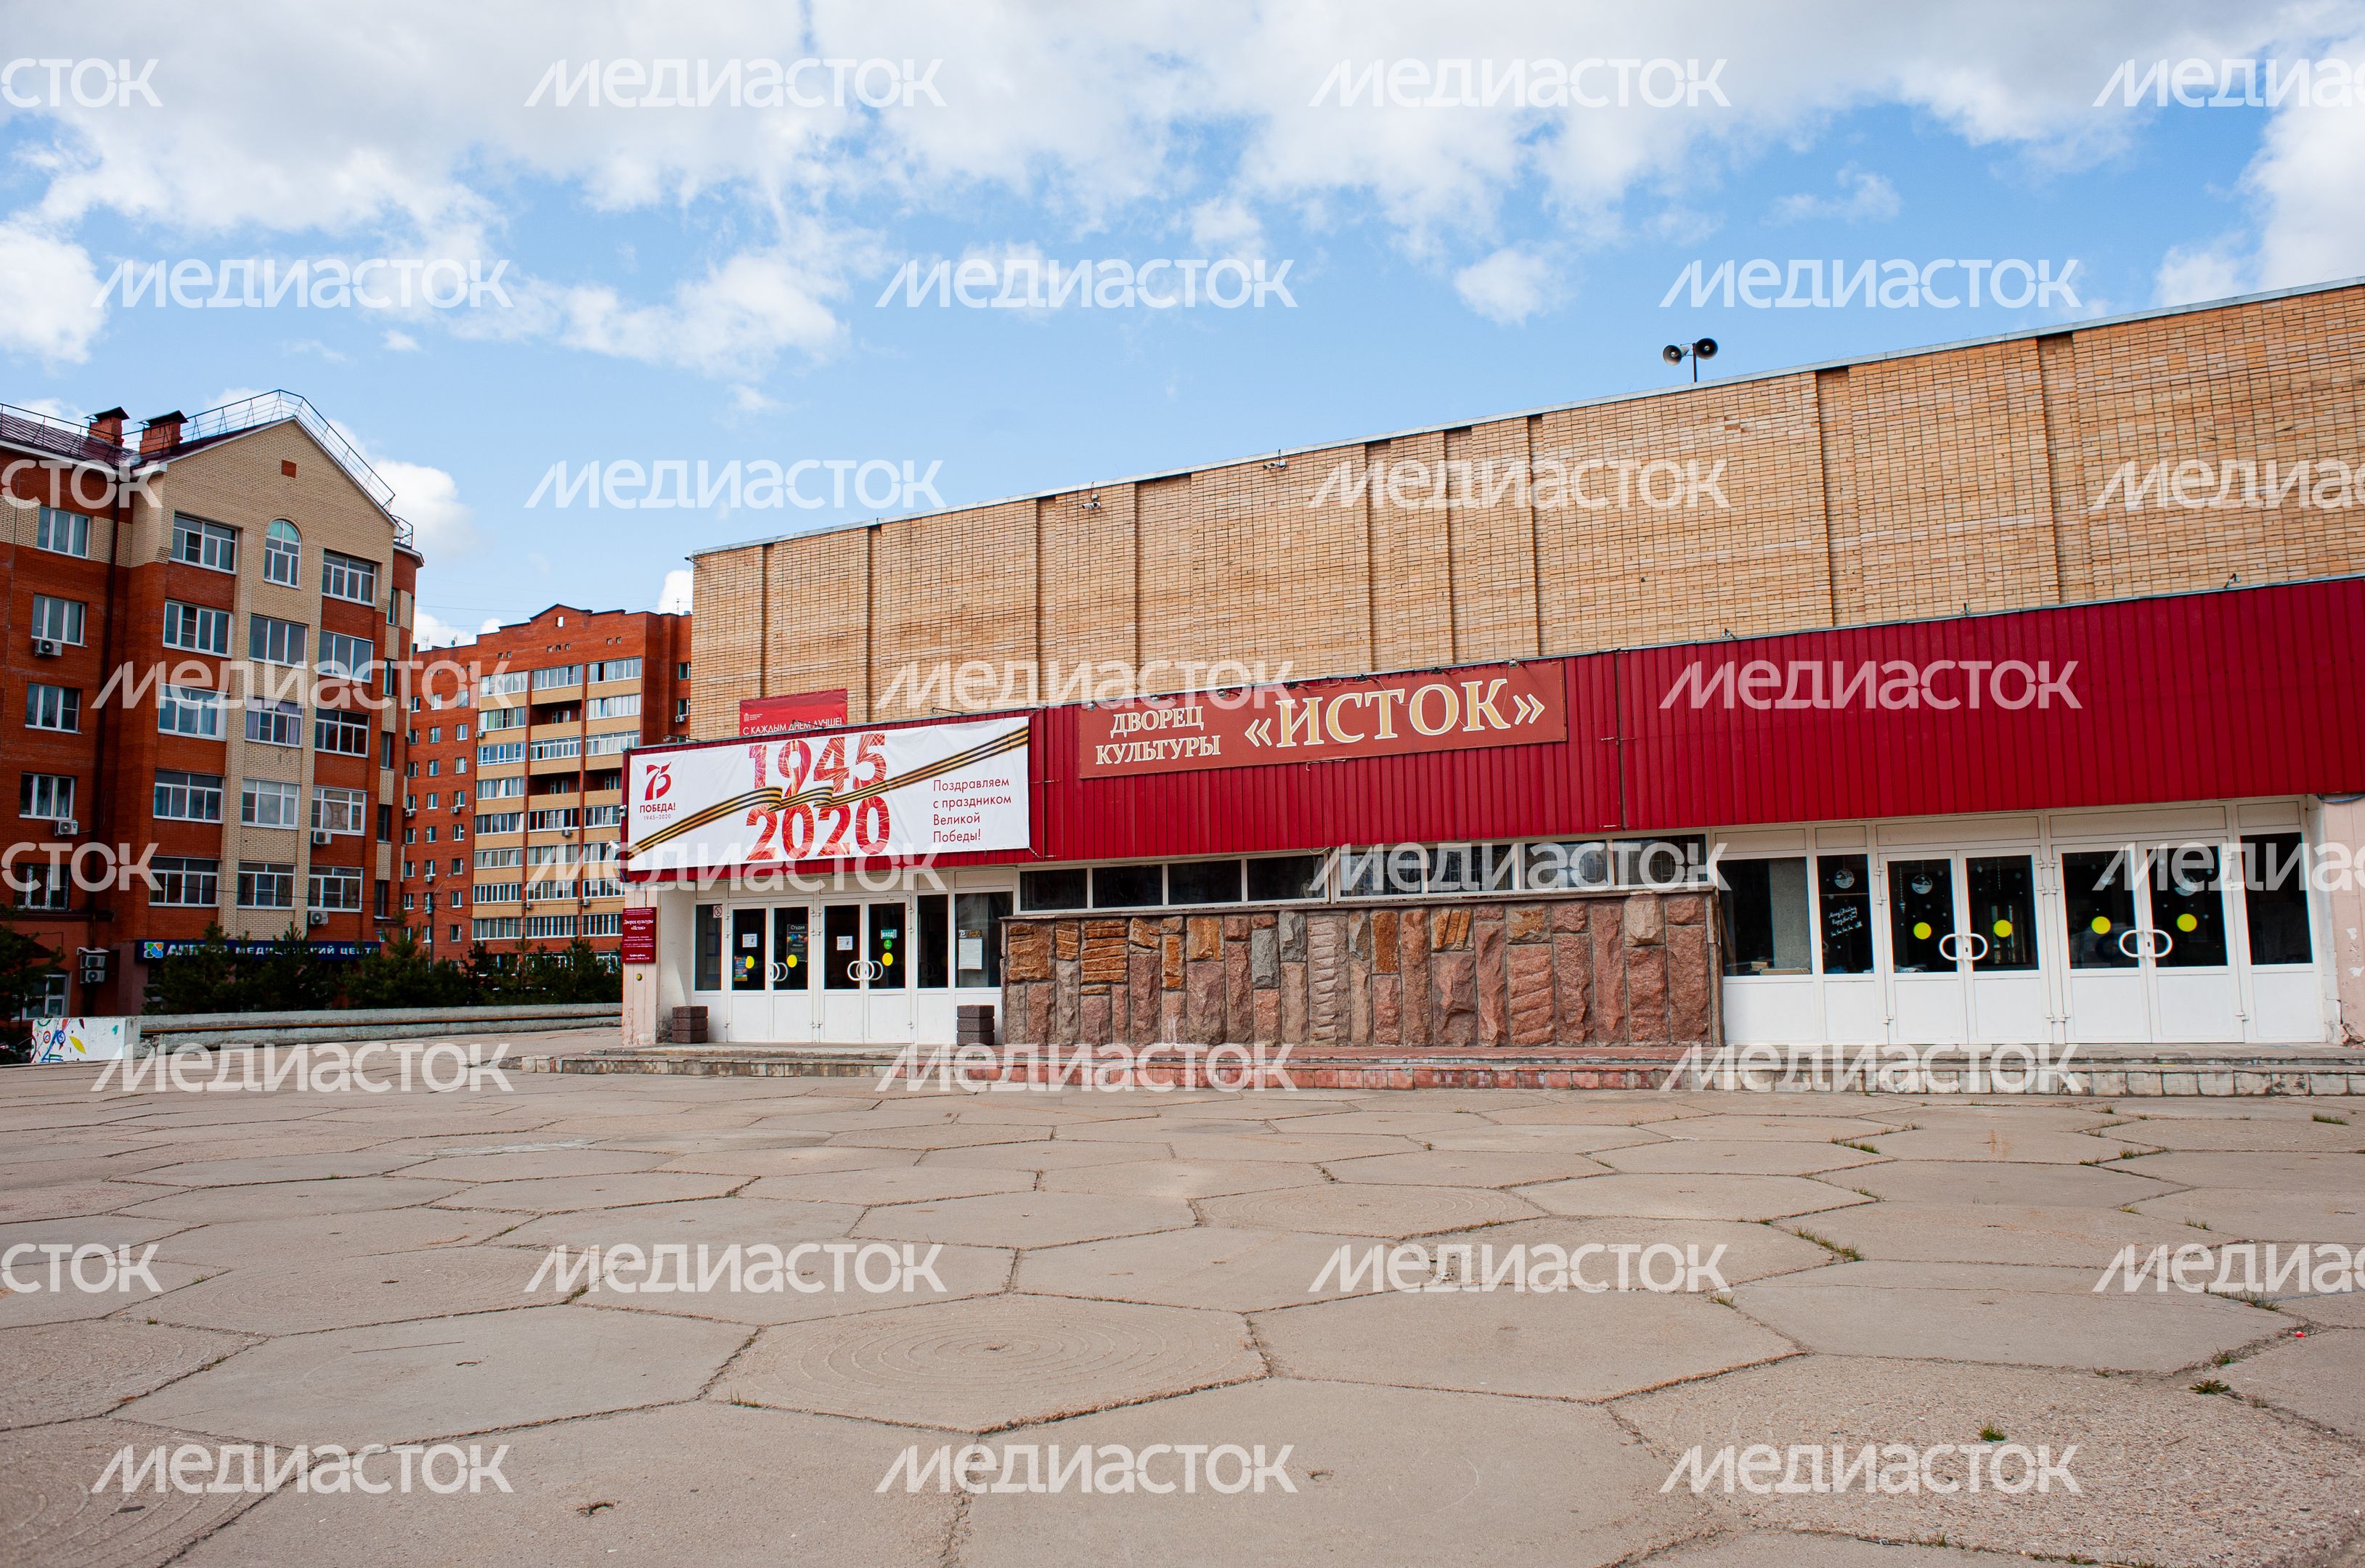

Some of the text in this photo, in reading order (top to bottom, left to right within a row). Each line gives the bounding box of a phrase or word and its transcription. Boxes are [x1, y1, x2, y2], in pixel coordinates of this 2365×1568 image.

[1110, 706, 1204, 739] ДВОРЕЦ
[1244, 678, 1545, 748] «ИСТОК»
[743, 727, 749, 735] С
[751, 723, 786, 735] КАЖДЫМ
[1095, 735, 1221, 766] КУЛЬТУРЫ
[749, 733, 886, 797] 1945
[645, 761, 672, 801] 75
[933, 778, 1010, 793] Поздравляем
[640, 802, 676, 814] ПОБЕДА!
[942, 796, 1011, 812] праздником
[746, 796, 890, 861] 2020
[933, 812, 980, 826] Великой
[933, 828, 981, 843] Победы!
